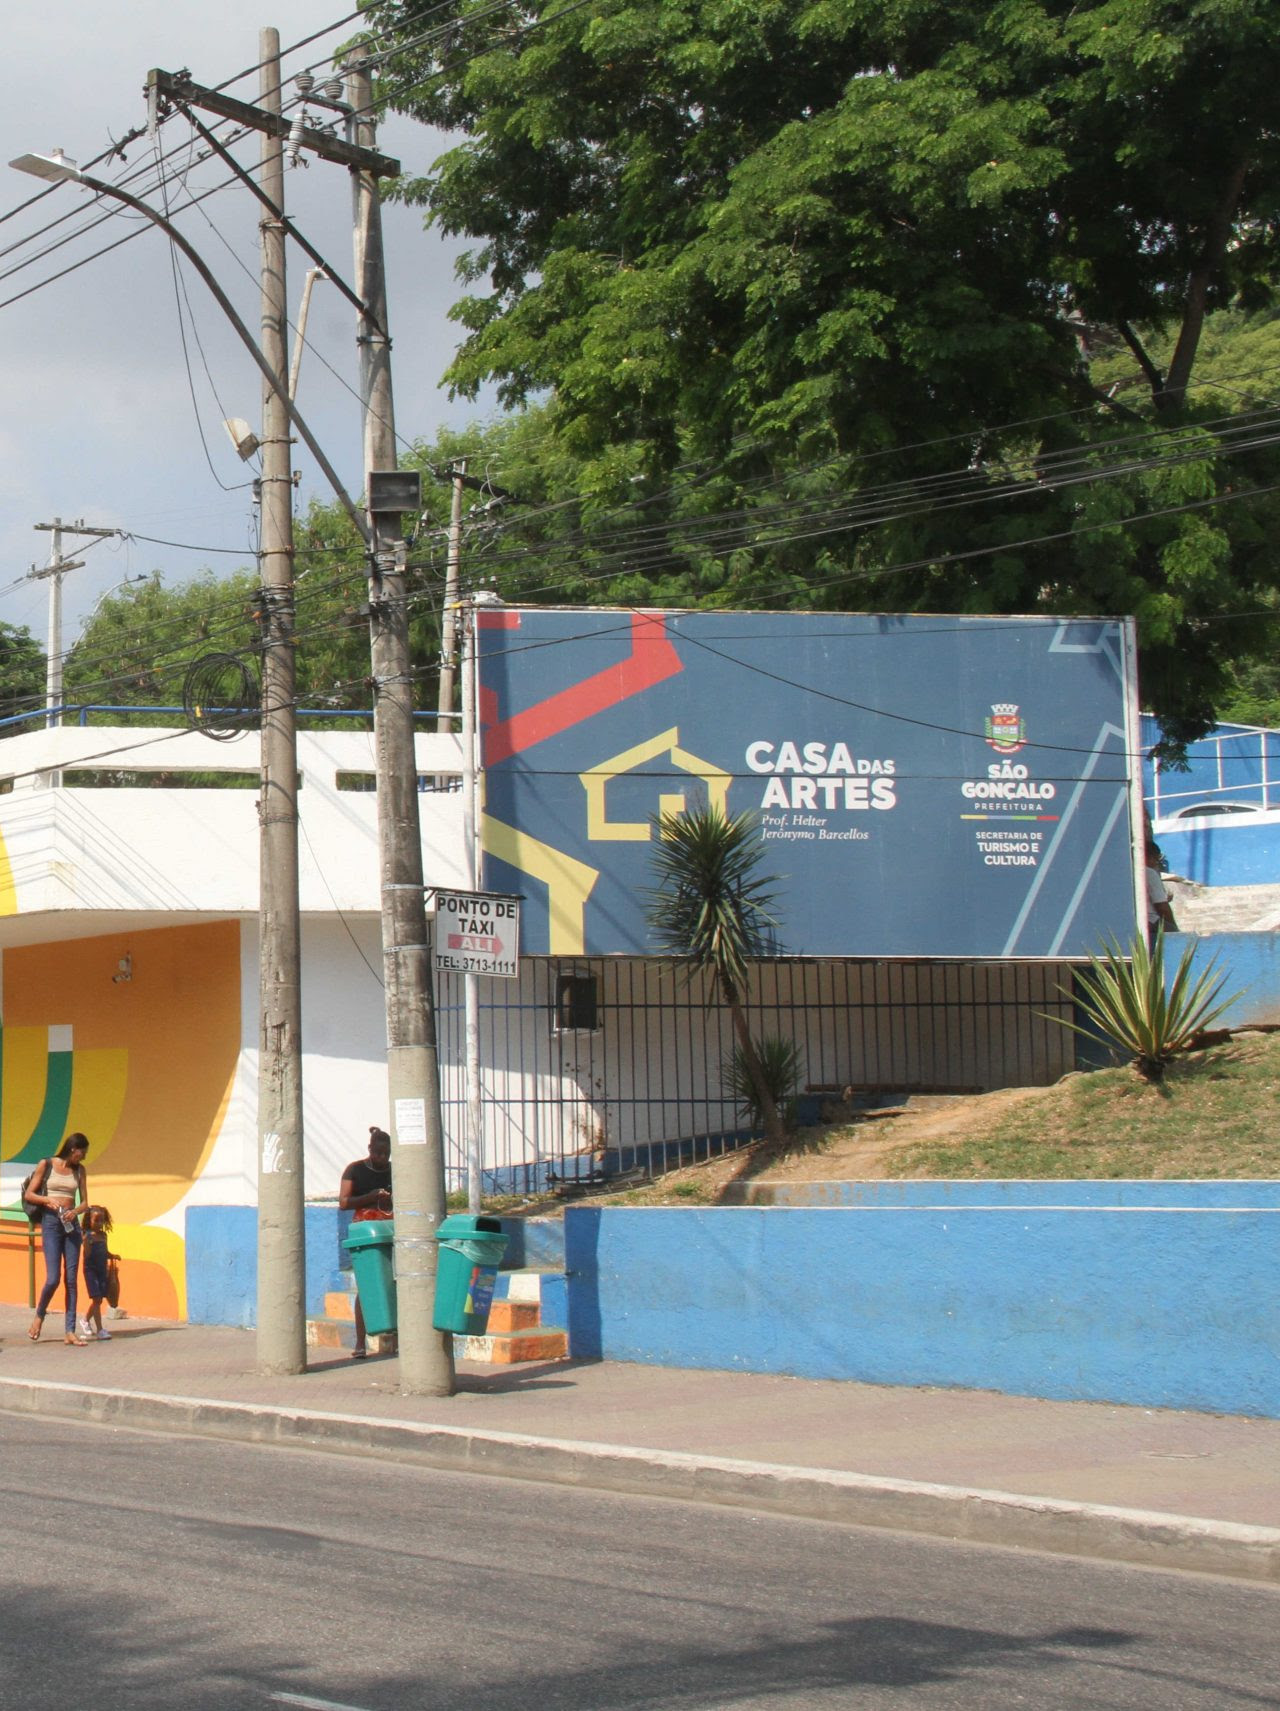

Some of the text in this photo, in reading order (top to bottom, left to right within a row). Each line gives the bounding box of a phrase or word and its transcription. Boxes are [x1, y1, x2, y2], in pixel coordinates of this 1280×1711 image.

[745, 740, 896, 775] CASA DAS
[988, 759, 1028, 780] SÃO
[760, 777, 897, 810] ARTES
[961, 781, 1056, 800] GONÇALO
[974, 802, 1044, 811] PREFEITURA
[761, 814, 789, 828] Prof.
[760, 827, 869, 841] Jerônymo Barcellos
[975, 831, 1043, 840] SECRETARIA DE
[977, 842, 1040, 853] TURISMO E
[984, 855, 1037, 866] CULTURA
[437, 897, 515, 918] PONTO DE
[458, 916, 494, 935] TÁXI
[461, 937, 493, 952] ALI
[436, 955, 516, 973] TEL: 3713-1111
